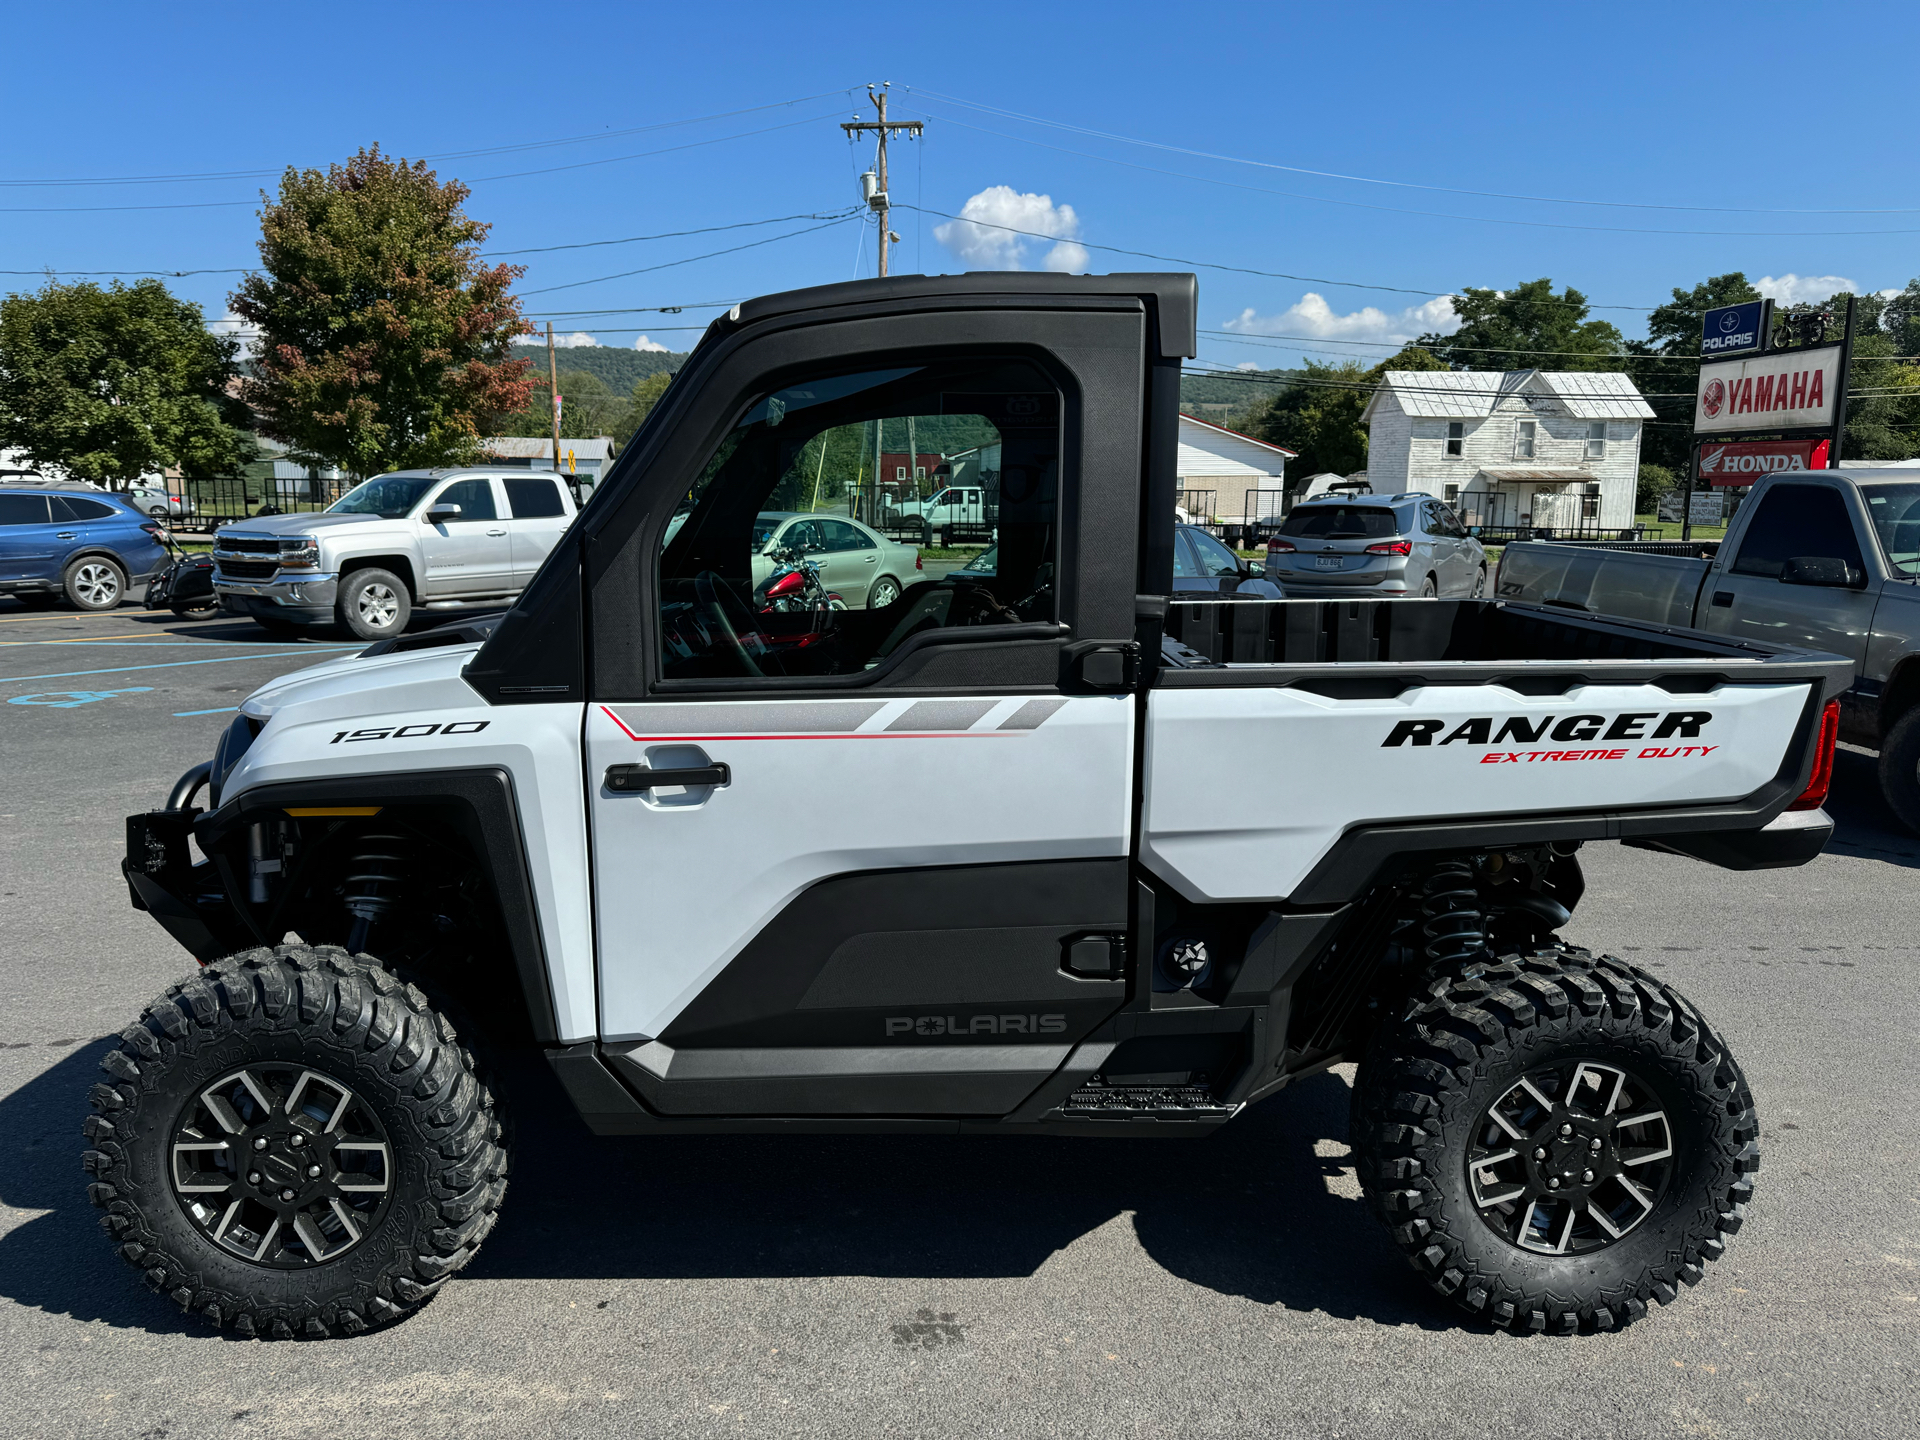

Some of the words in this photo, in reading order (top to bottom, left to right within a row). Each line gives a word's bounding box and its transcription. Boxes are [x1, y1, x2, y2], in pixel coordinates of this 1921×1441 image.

[1703, 332, 1753, 350] POLARIS
[1728, 369, 1823, 415] YAMAHA
[1722, 454, 1807, 472] HONDA
[329, 721, 491, 744] 1500
[1380, 711, 1713, 748] RANGER
[1479, 748, 1630, 764] EXTREME
[1636, 745, 1720, 759] DUTY
[885, 1014, 1068, 1037] POLARIS
[181, 1043, 262, 1086] KENDA
[350, 1204, 411, 1279] CROSS
